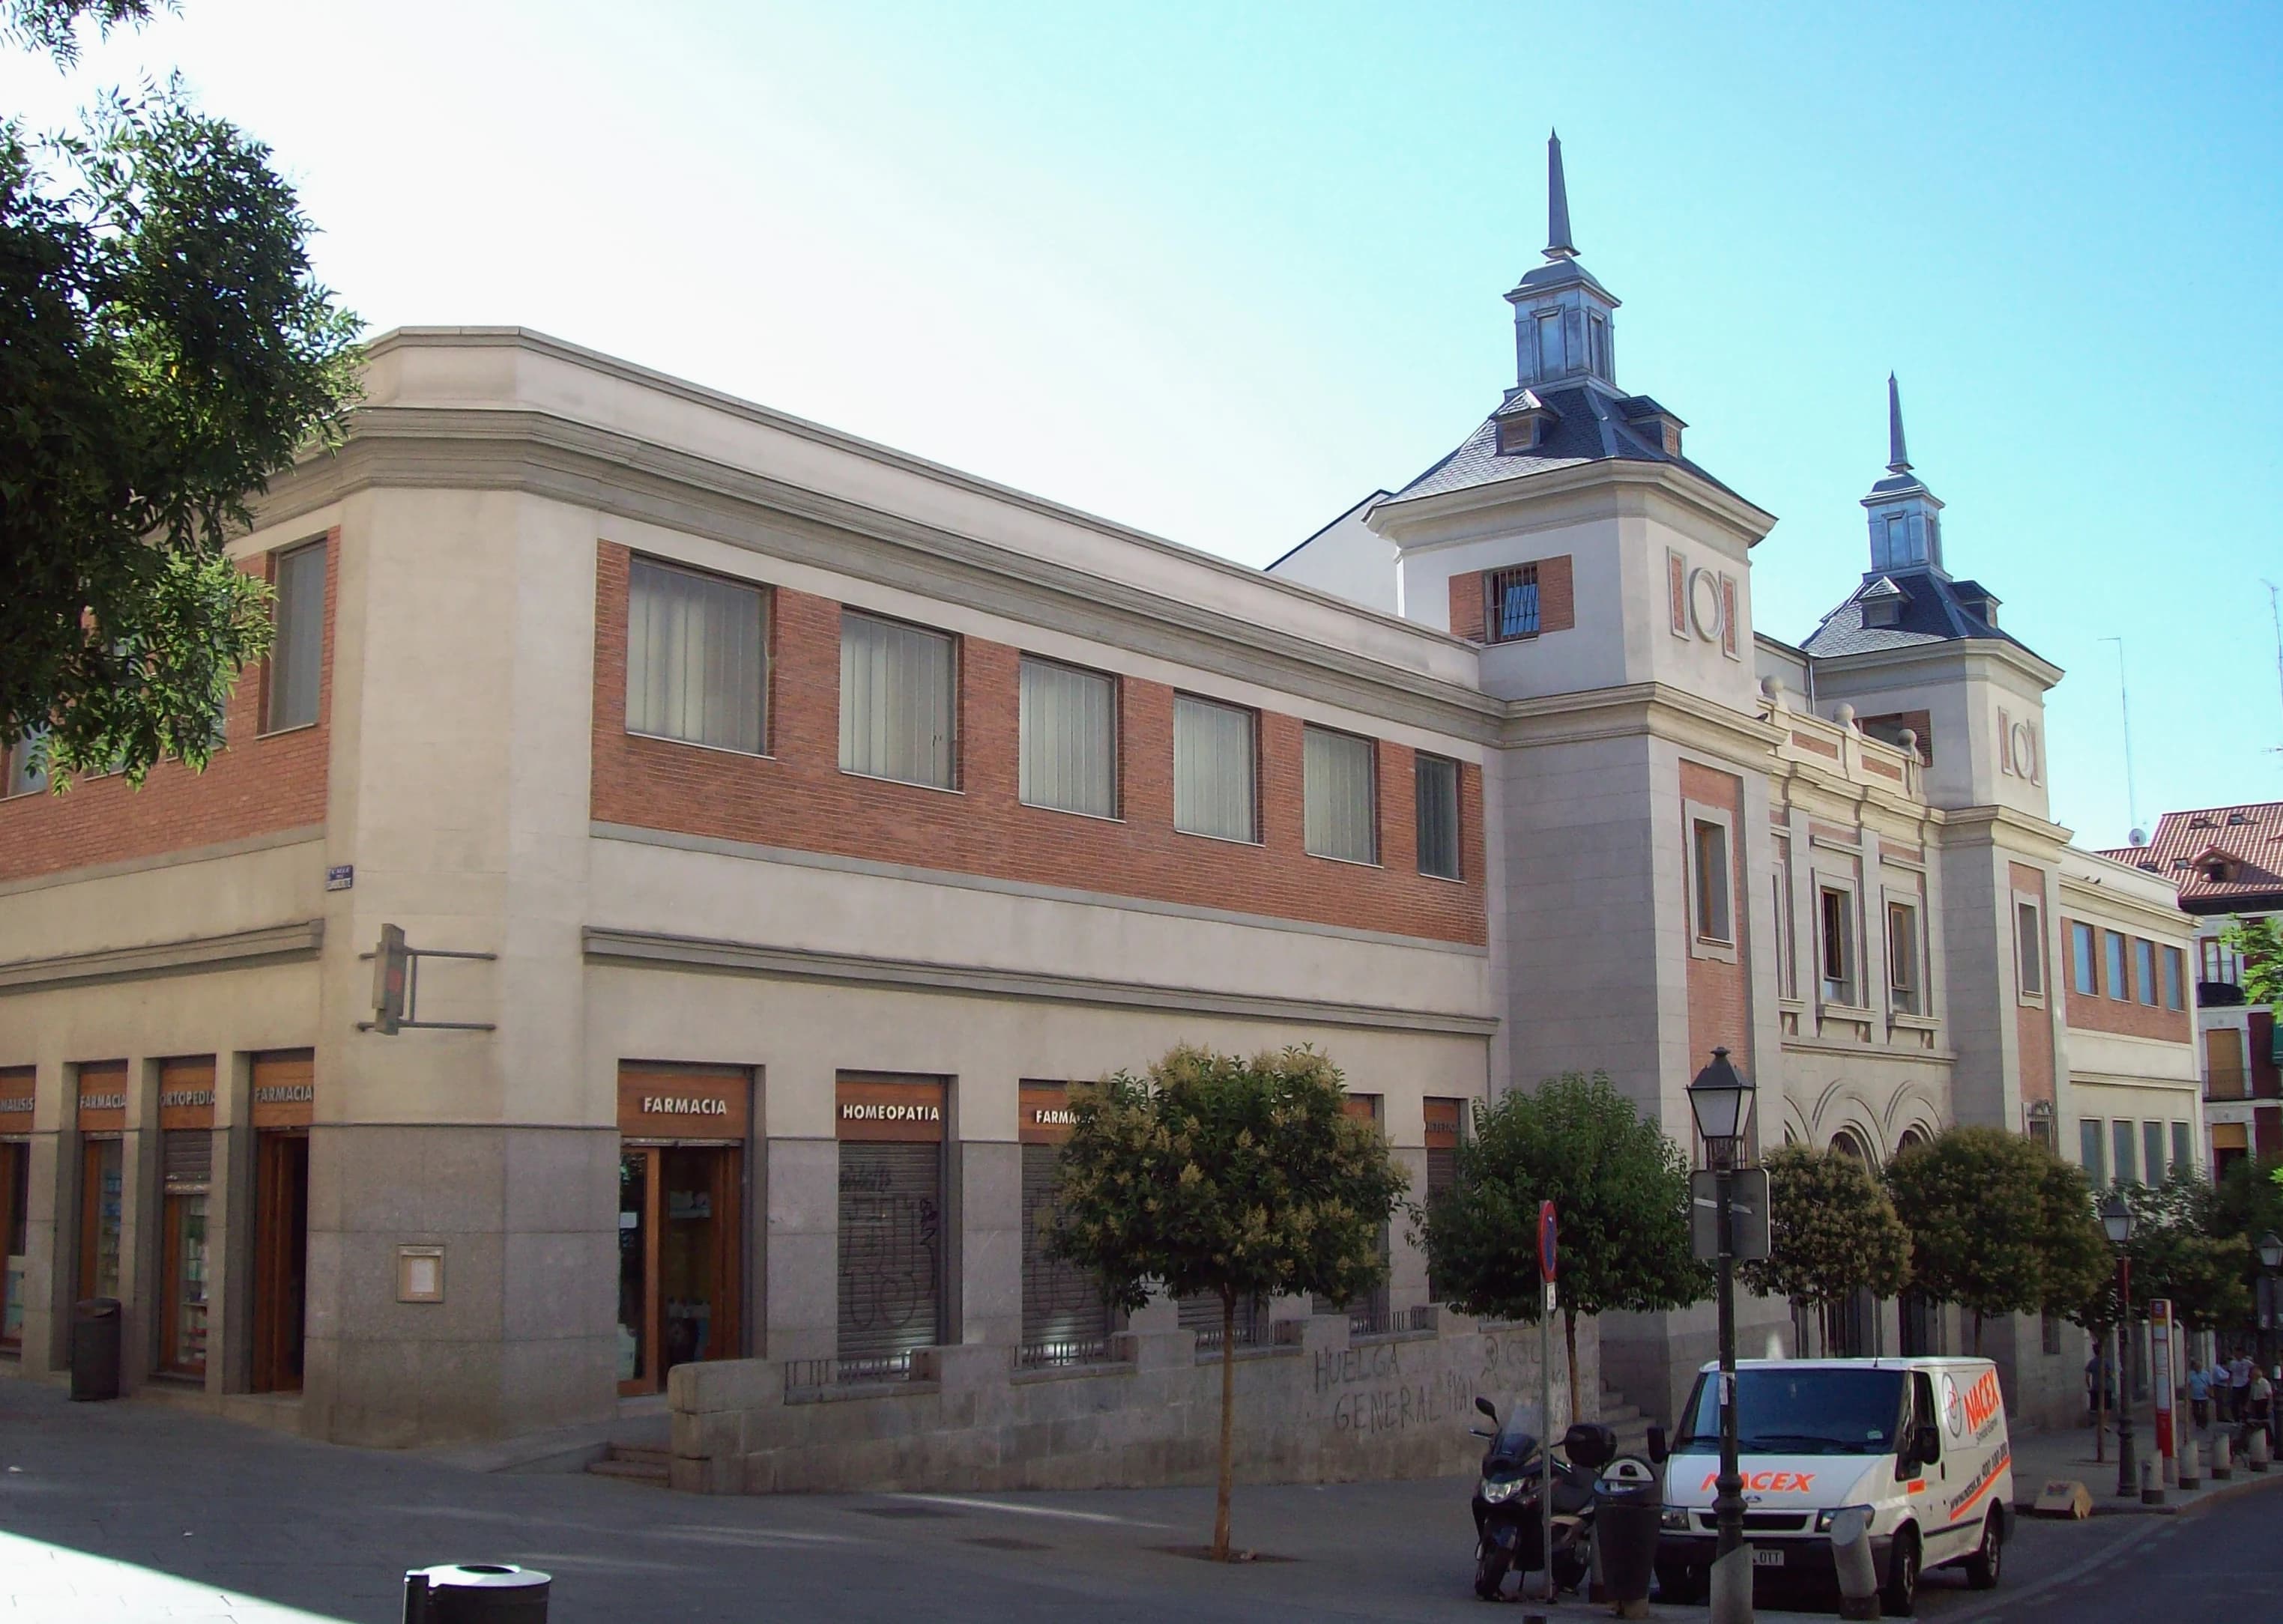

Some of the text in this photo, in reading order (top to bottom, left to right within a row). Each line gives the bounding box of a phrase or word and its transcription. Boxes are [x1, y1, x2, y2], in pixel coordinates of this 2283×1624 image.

[79, 1094, 126, 1109] FARMACIA
[159, 1091, 216, 1106] ORTOPEDIA
[255, 1085, 312, 1103] FARMACIA
[644, 1097, 728, 1115] FARMACIA
[843, 1104, 940, 1121] HOMEOPATIA
[1316, 1343, 1400, 1394] HUELGA
[1334, 1386, 1441, 1434] GENERAL
[1963, 1369, 2000, 1435] NACEX
